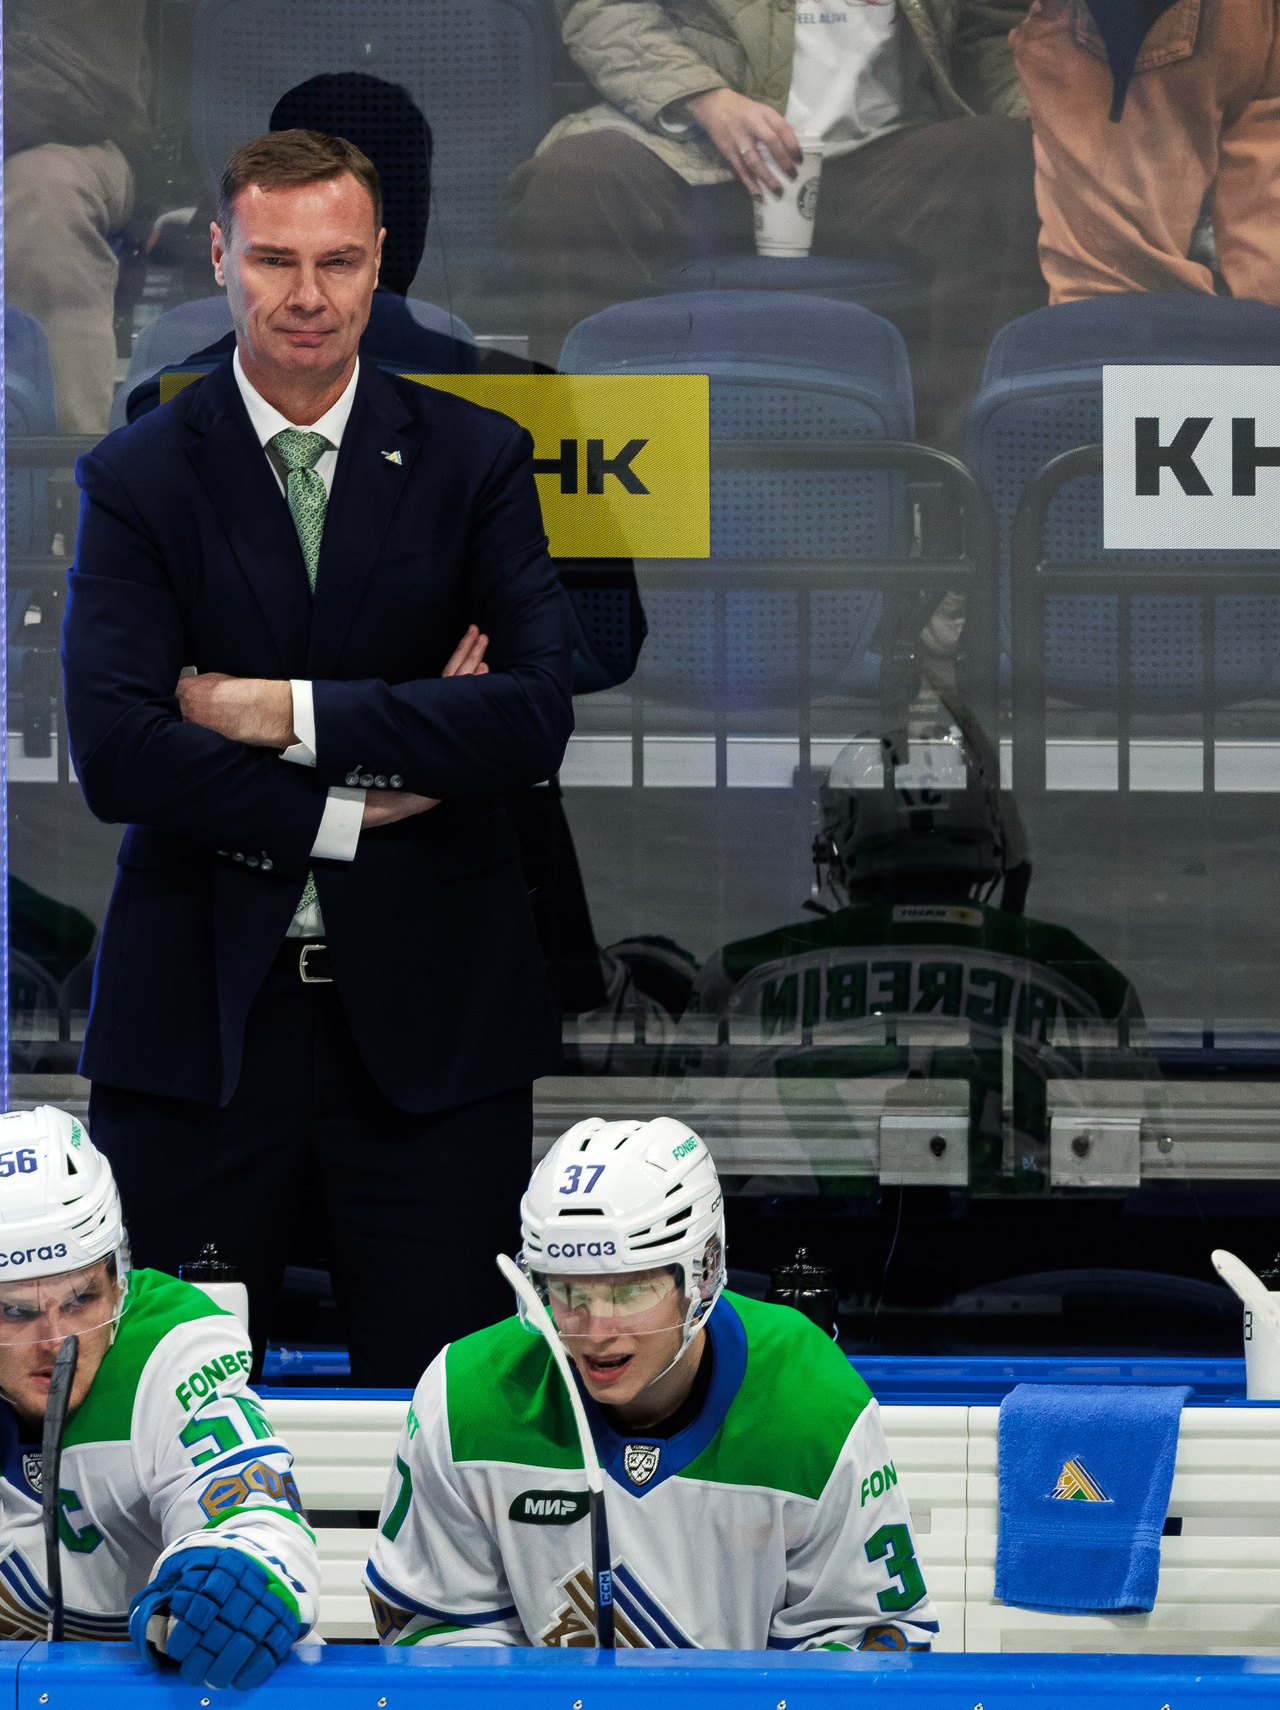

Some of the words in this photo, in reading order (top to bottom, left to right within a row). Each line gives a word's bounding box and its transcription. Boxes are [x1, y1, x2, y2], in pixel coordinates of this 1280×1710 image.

[672, 1135, 700, 1161] FONBET
[559, 1164, 606, 1195] 37
[547, 1241, 616, 1258] согаз
[175, 1350, 253, 1412] FONBE
[524, 1498, 577, 1516] МИР
[864, 1523, 927, 1613] 3
[599, 1570, 612, 1606] CCM
